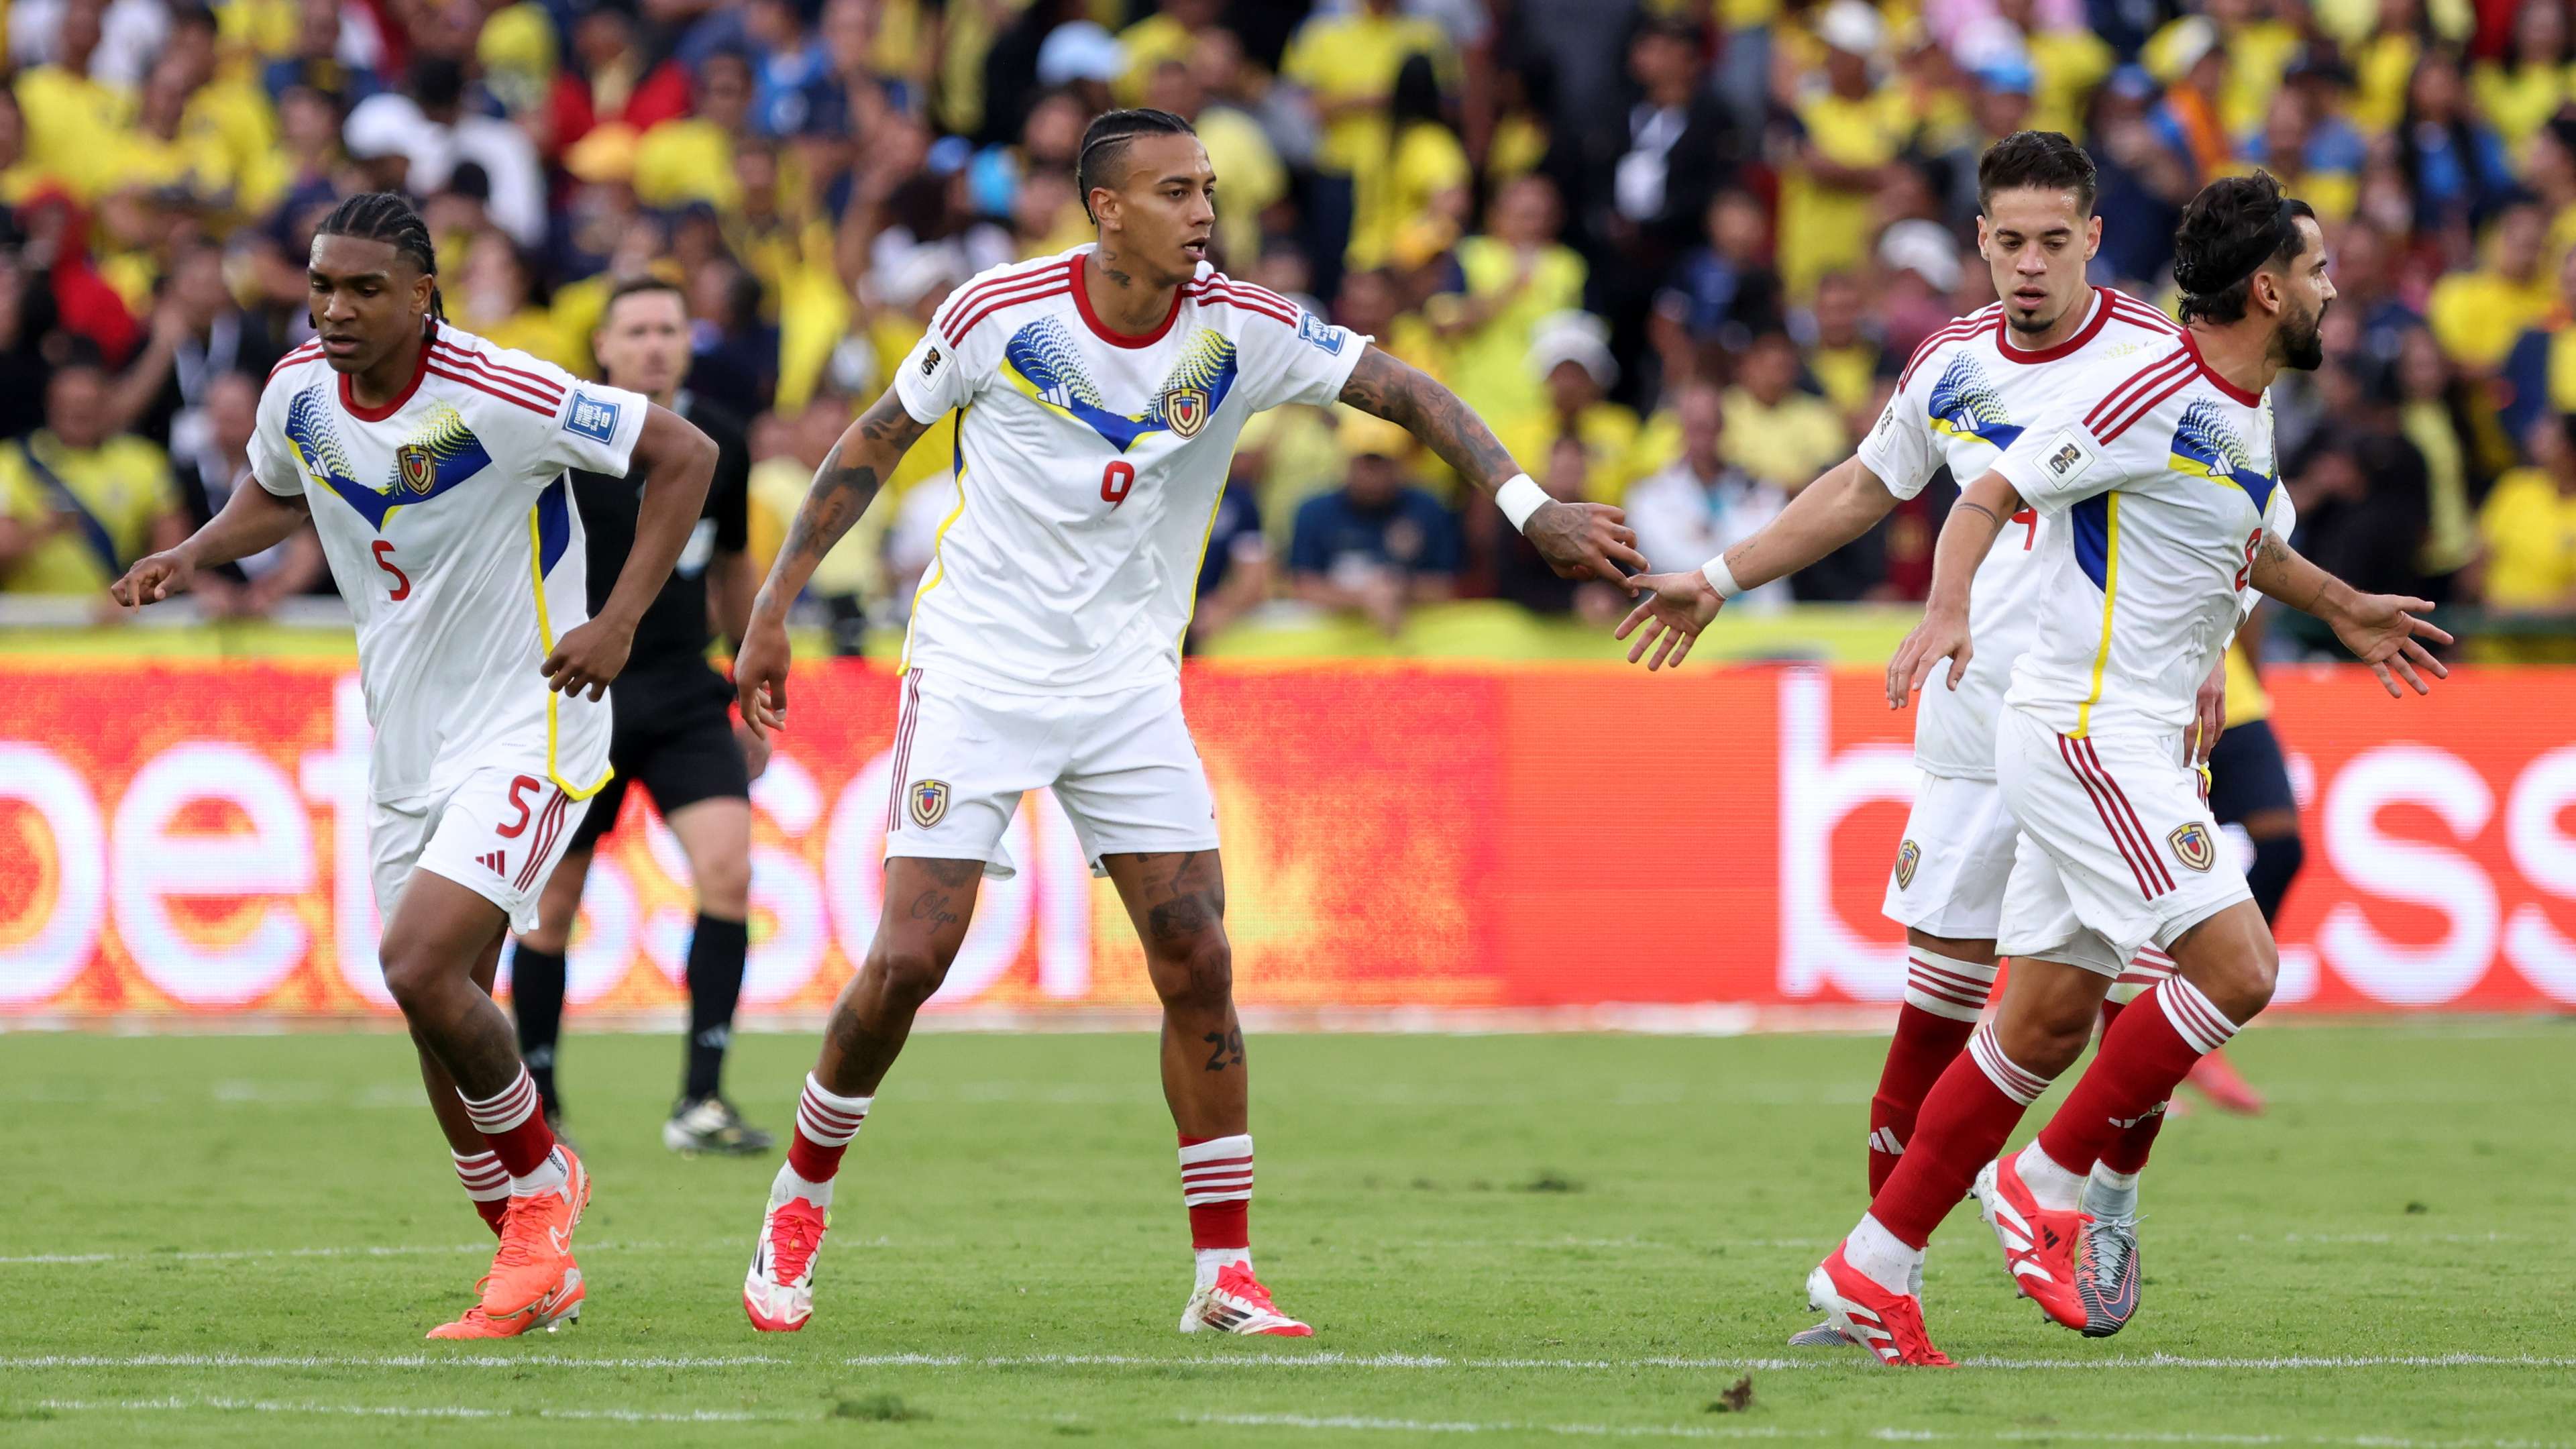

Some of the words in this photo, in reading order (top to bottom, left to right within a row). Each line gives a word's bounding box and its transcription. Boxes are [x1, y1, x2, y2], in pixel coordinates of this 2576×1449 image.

[580, 403, 594, 427] UNITES
[1100, 461, 1135, 514] 9
[372, 540, 411, 601] 5
[496, 775, 540, 839] 5
[0, 671, 1092, 1006] etso
[1203, 1025, 1243, 1071] 29
